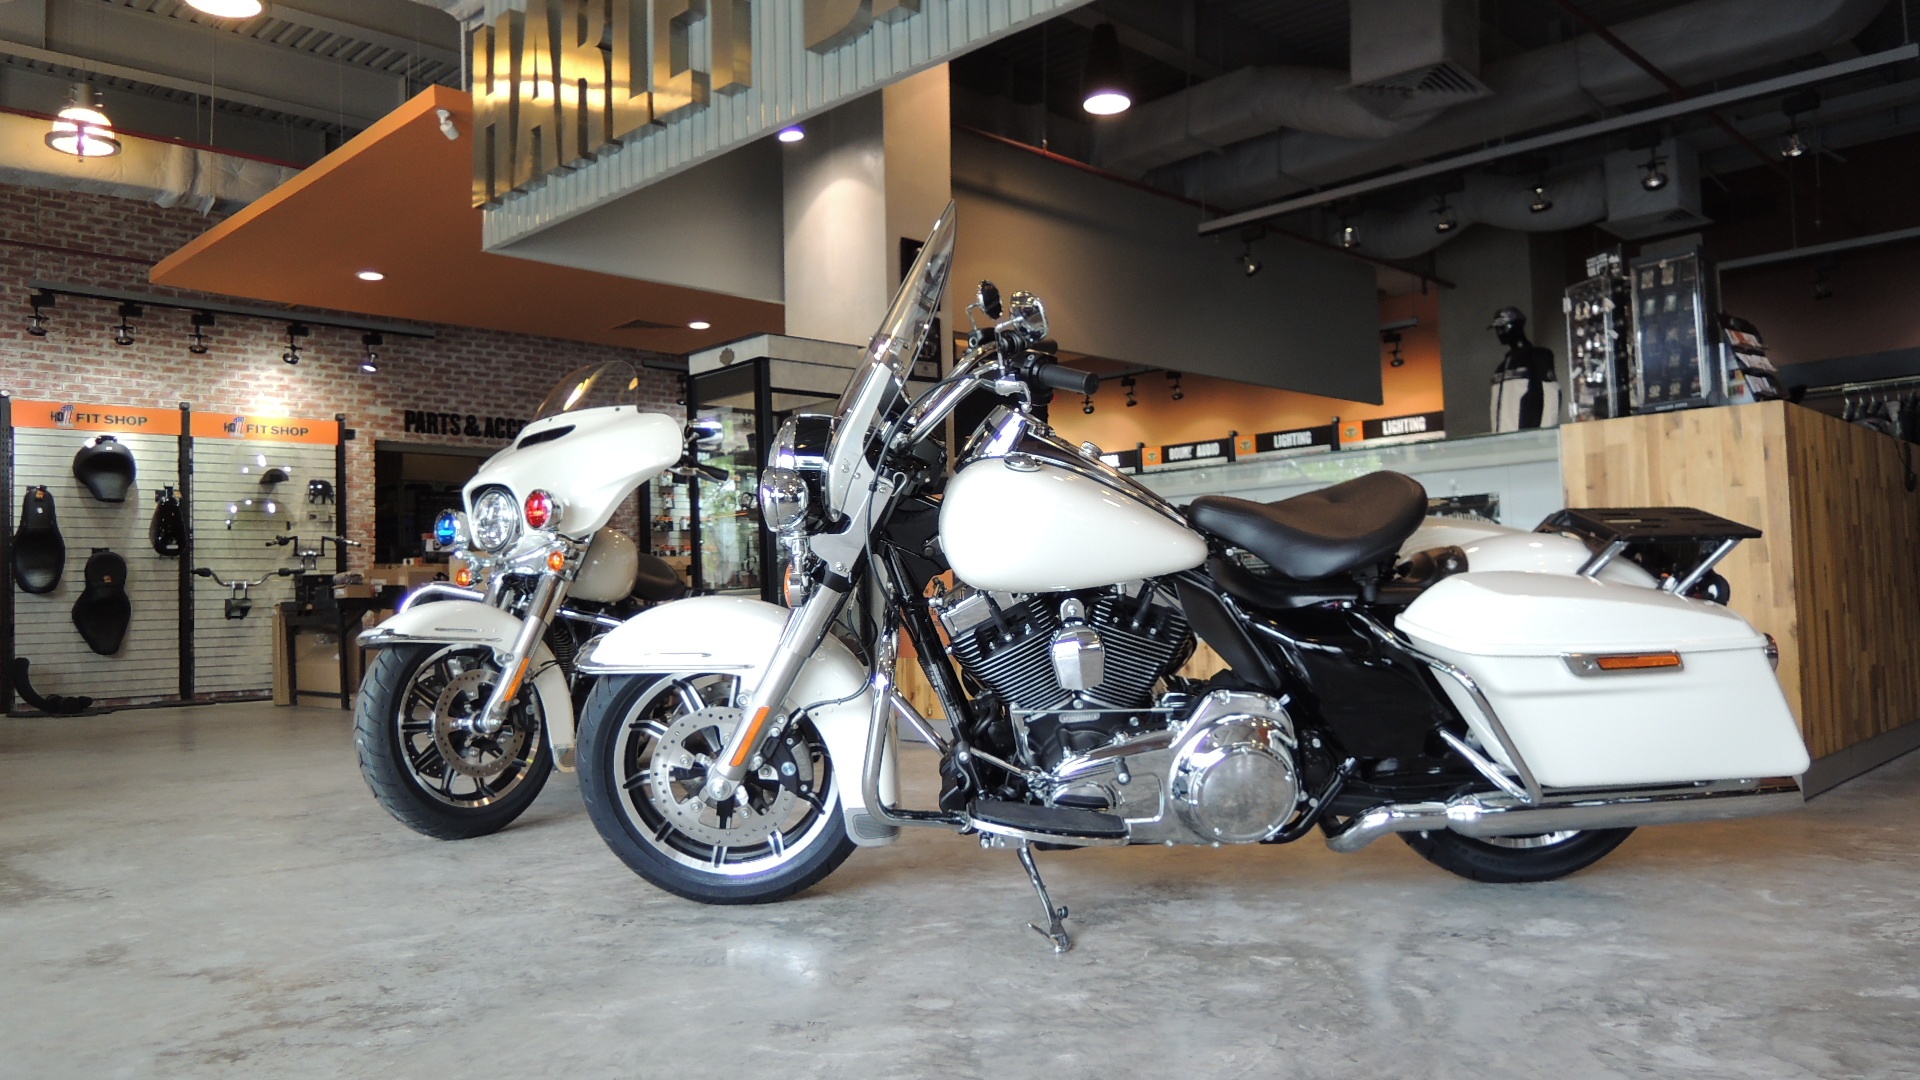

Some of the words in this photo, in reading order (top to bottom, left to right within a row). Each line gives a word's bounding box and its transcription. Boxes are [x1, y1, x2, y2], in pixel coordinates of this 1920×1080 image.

[76, 411, 101, 424] FIT
[104, 414, 148, 427] SHOP
[405, 410, 460, 436] PARTS
[464, 415, 481, 436] &
[1381, 416, 1427, 436] LIGHTING
[246, 423, 268, 434] FIT
[270, 425, 309, 437] SHOP
[1273, 431, 1313, 449] LIGHTING
